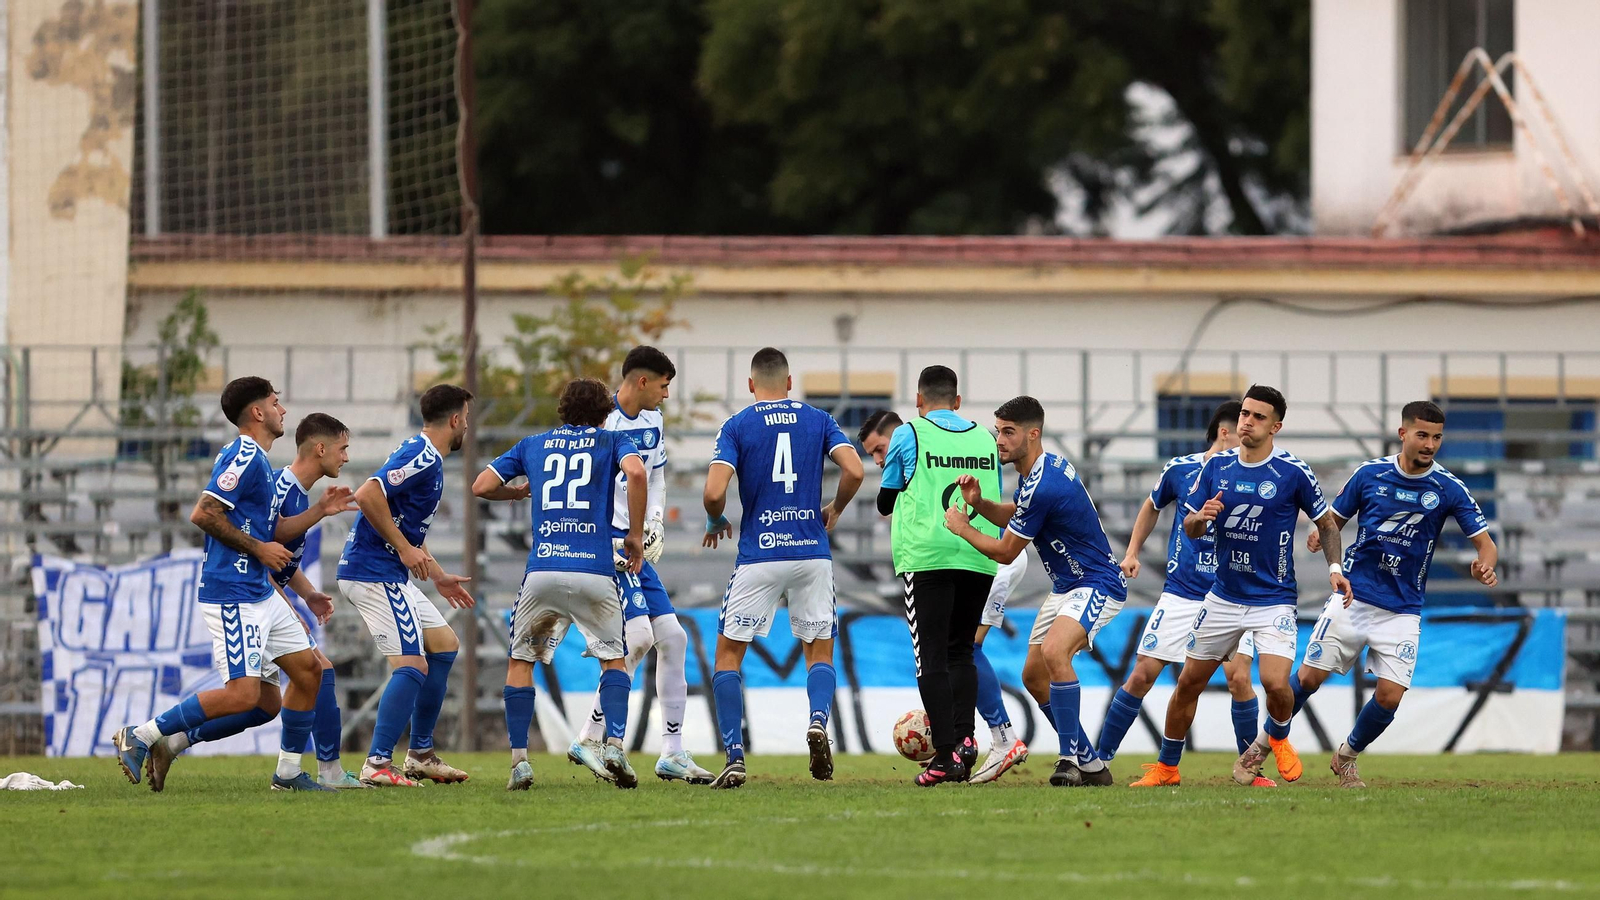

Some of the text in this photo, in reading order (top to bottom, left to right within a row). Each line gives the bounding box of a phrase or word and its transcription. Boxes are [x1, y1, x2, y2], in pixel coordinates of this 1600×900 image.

[764, 412, 797, 426] HUGO
[544, 438, 595, 450] BETO PLAZA
[772, 432, 797, 493] 4
[926, 451, 995, 470] hummel
[542, 452, 593, 511] 22
[1239, 517, 1263, 532] Air
[1395, 523, 1419, 538] Air
[644, 532, 657, 550] NAT
[776, 533, 792, 541] High
[776, 539, 819, 547] ProNutrition
[1225, 530, 1259, 542] oneair.es
[1377, 534, 1412, 548] oneair.es
[552, 551, 596, 559] ProNutrition
[553, 544, 570, 552] High
[1231, 550, 1250, 564] L3G
[1381, 552, 1402, 567] L3G
[1151, 609, 1165, 630] 3
[1315, 617, 1332, 640] 11
[245, 624, 261, 649] 23
